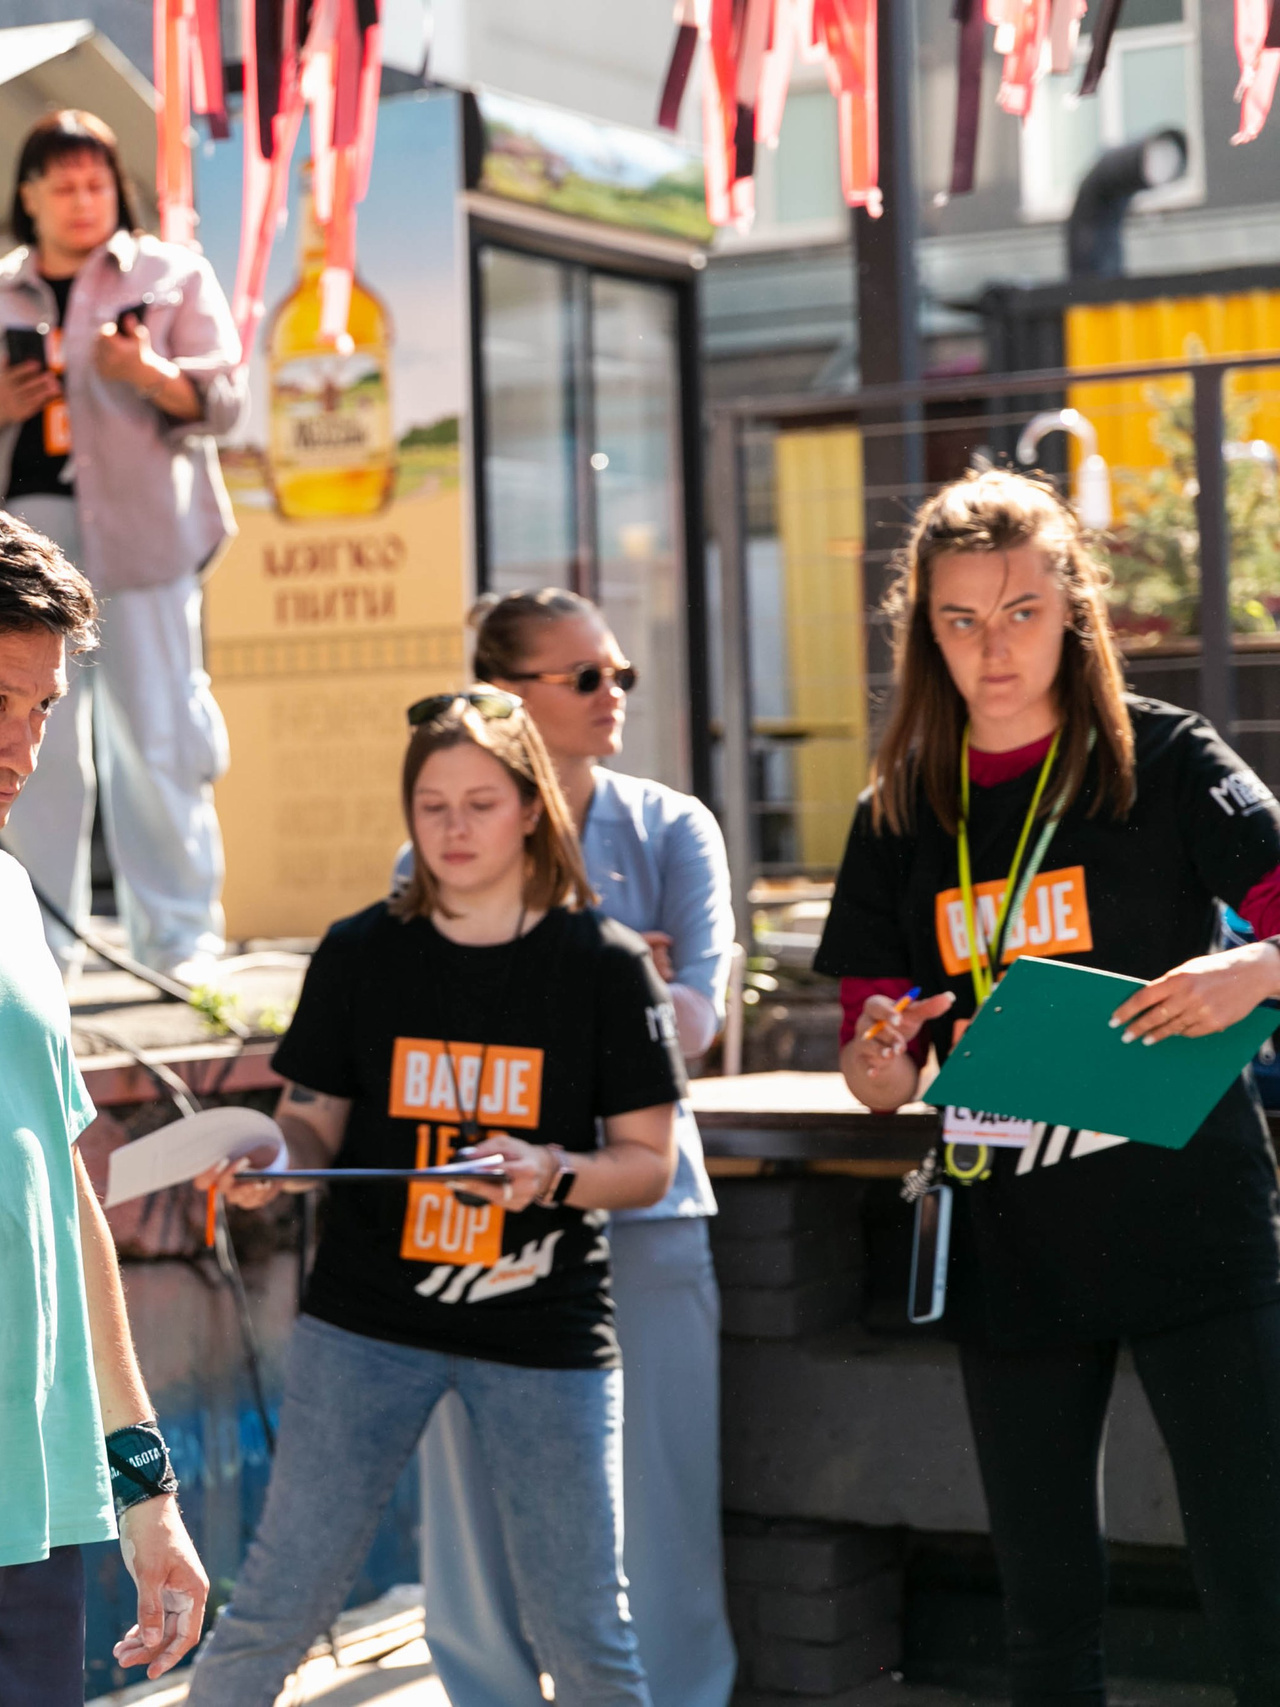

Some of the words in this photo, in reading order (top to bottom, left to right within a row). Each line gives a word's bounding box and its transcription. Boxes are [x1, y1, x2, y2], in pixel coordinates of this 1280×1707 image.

[404, 1050, 531, 1116] BABJE
[413, 1193, 491, 1254] CUP
[125, 1447, 161, 1468] АБОТА
